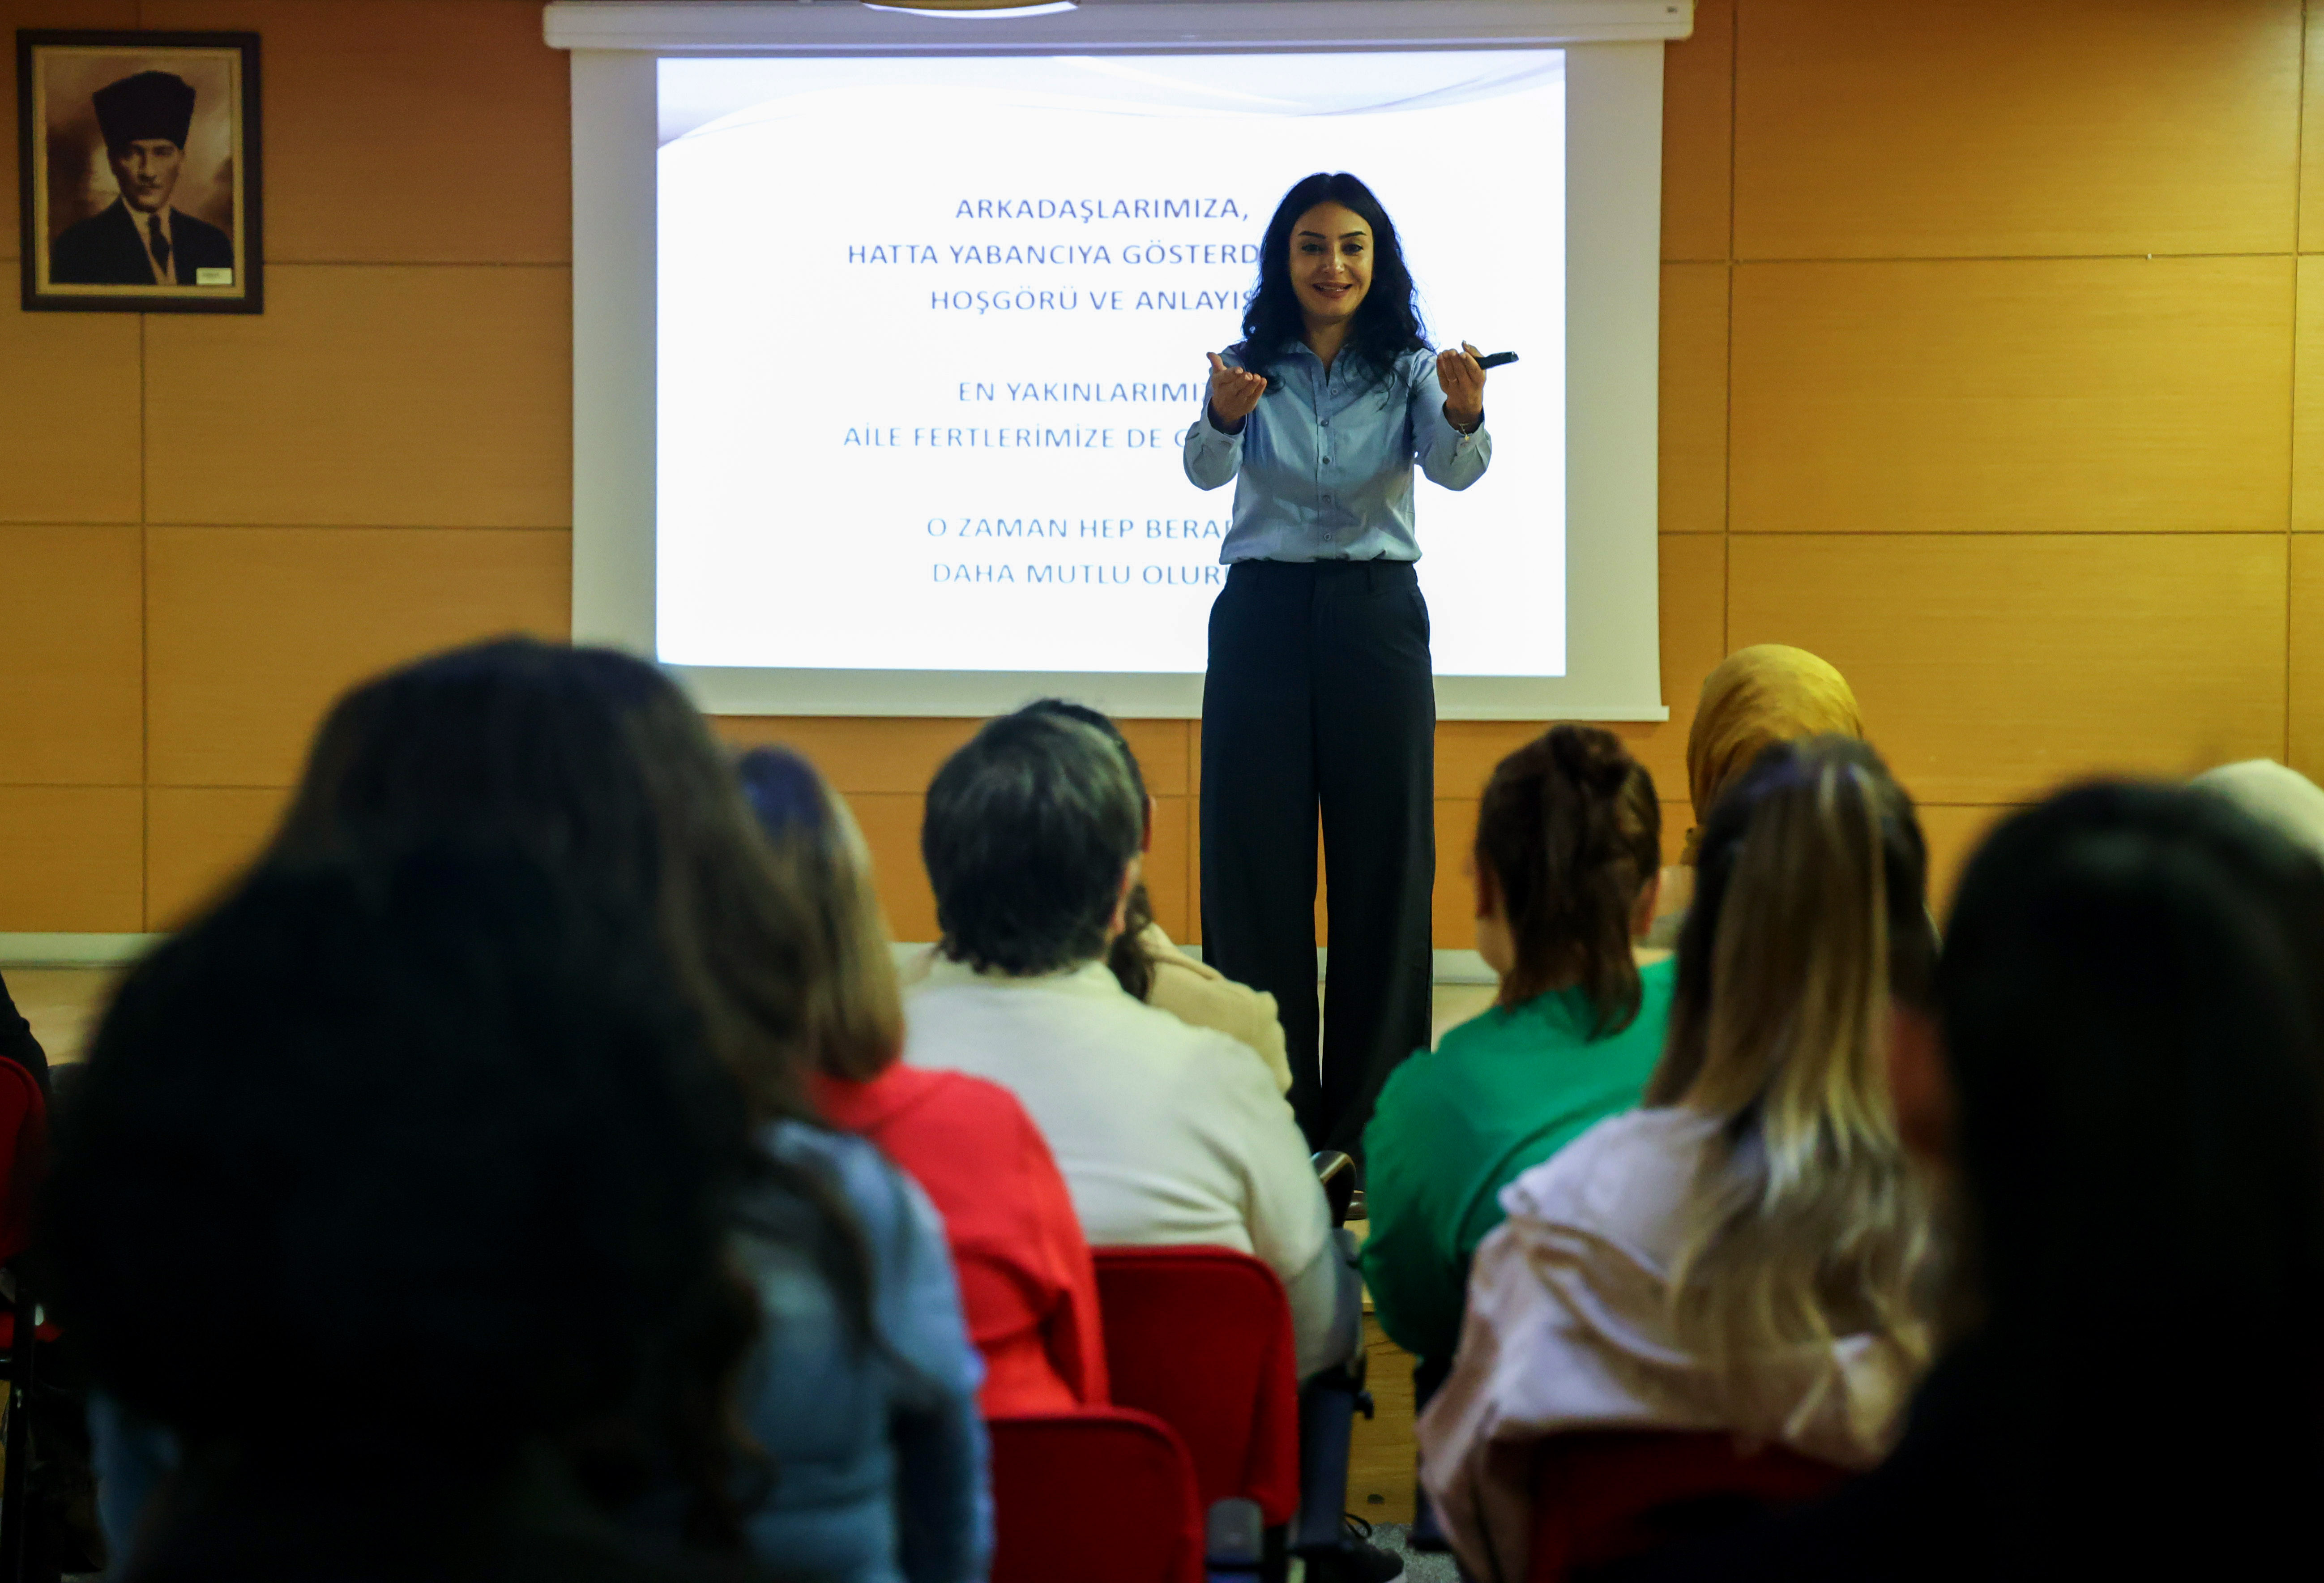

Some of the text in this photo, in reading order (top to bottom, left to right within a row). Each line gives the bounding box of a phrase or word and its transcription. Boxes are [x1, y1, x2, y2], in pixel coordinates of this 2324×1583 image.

[955, 198, 1248, 223] ARKADAŞLARIMIZA,
[848, 240, 1259, 265] HATTA YABANCIYA GÖSTERD
[931, 286, 1077, 315] HOŞGÖRÜ
[1089, 291, 1123, 310] VE
[959, 382, 994, 402] EN
[843, 423, 900, 447] AİLE
[914, 424, 1113, 448] FERTLERİMİZE
[1128, 428, 1161, 448] DE
[927, 518, 947, 537] O
[958, 518, 1067, 538] ZAMAN
[1080, 519, 1134, 539] HEP
[933, 564, 1228, 585] DAHA MUTLU OLUR
